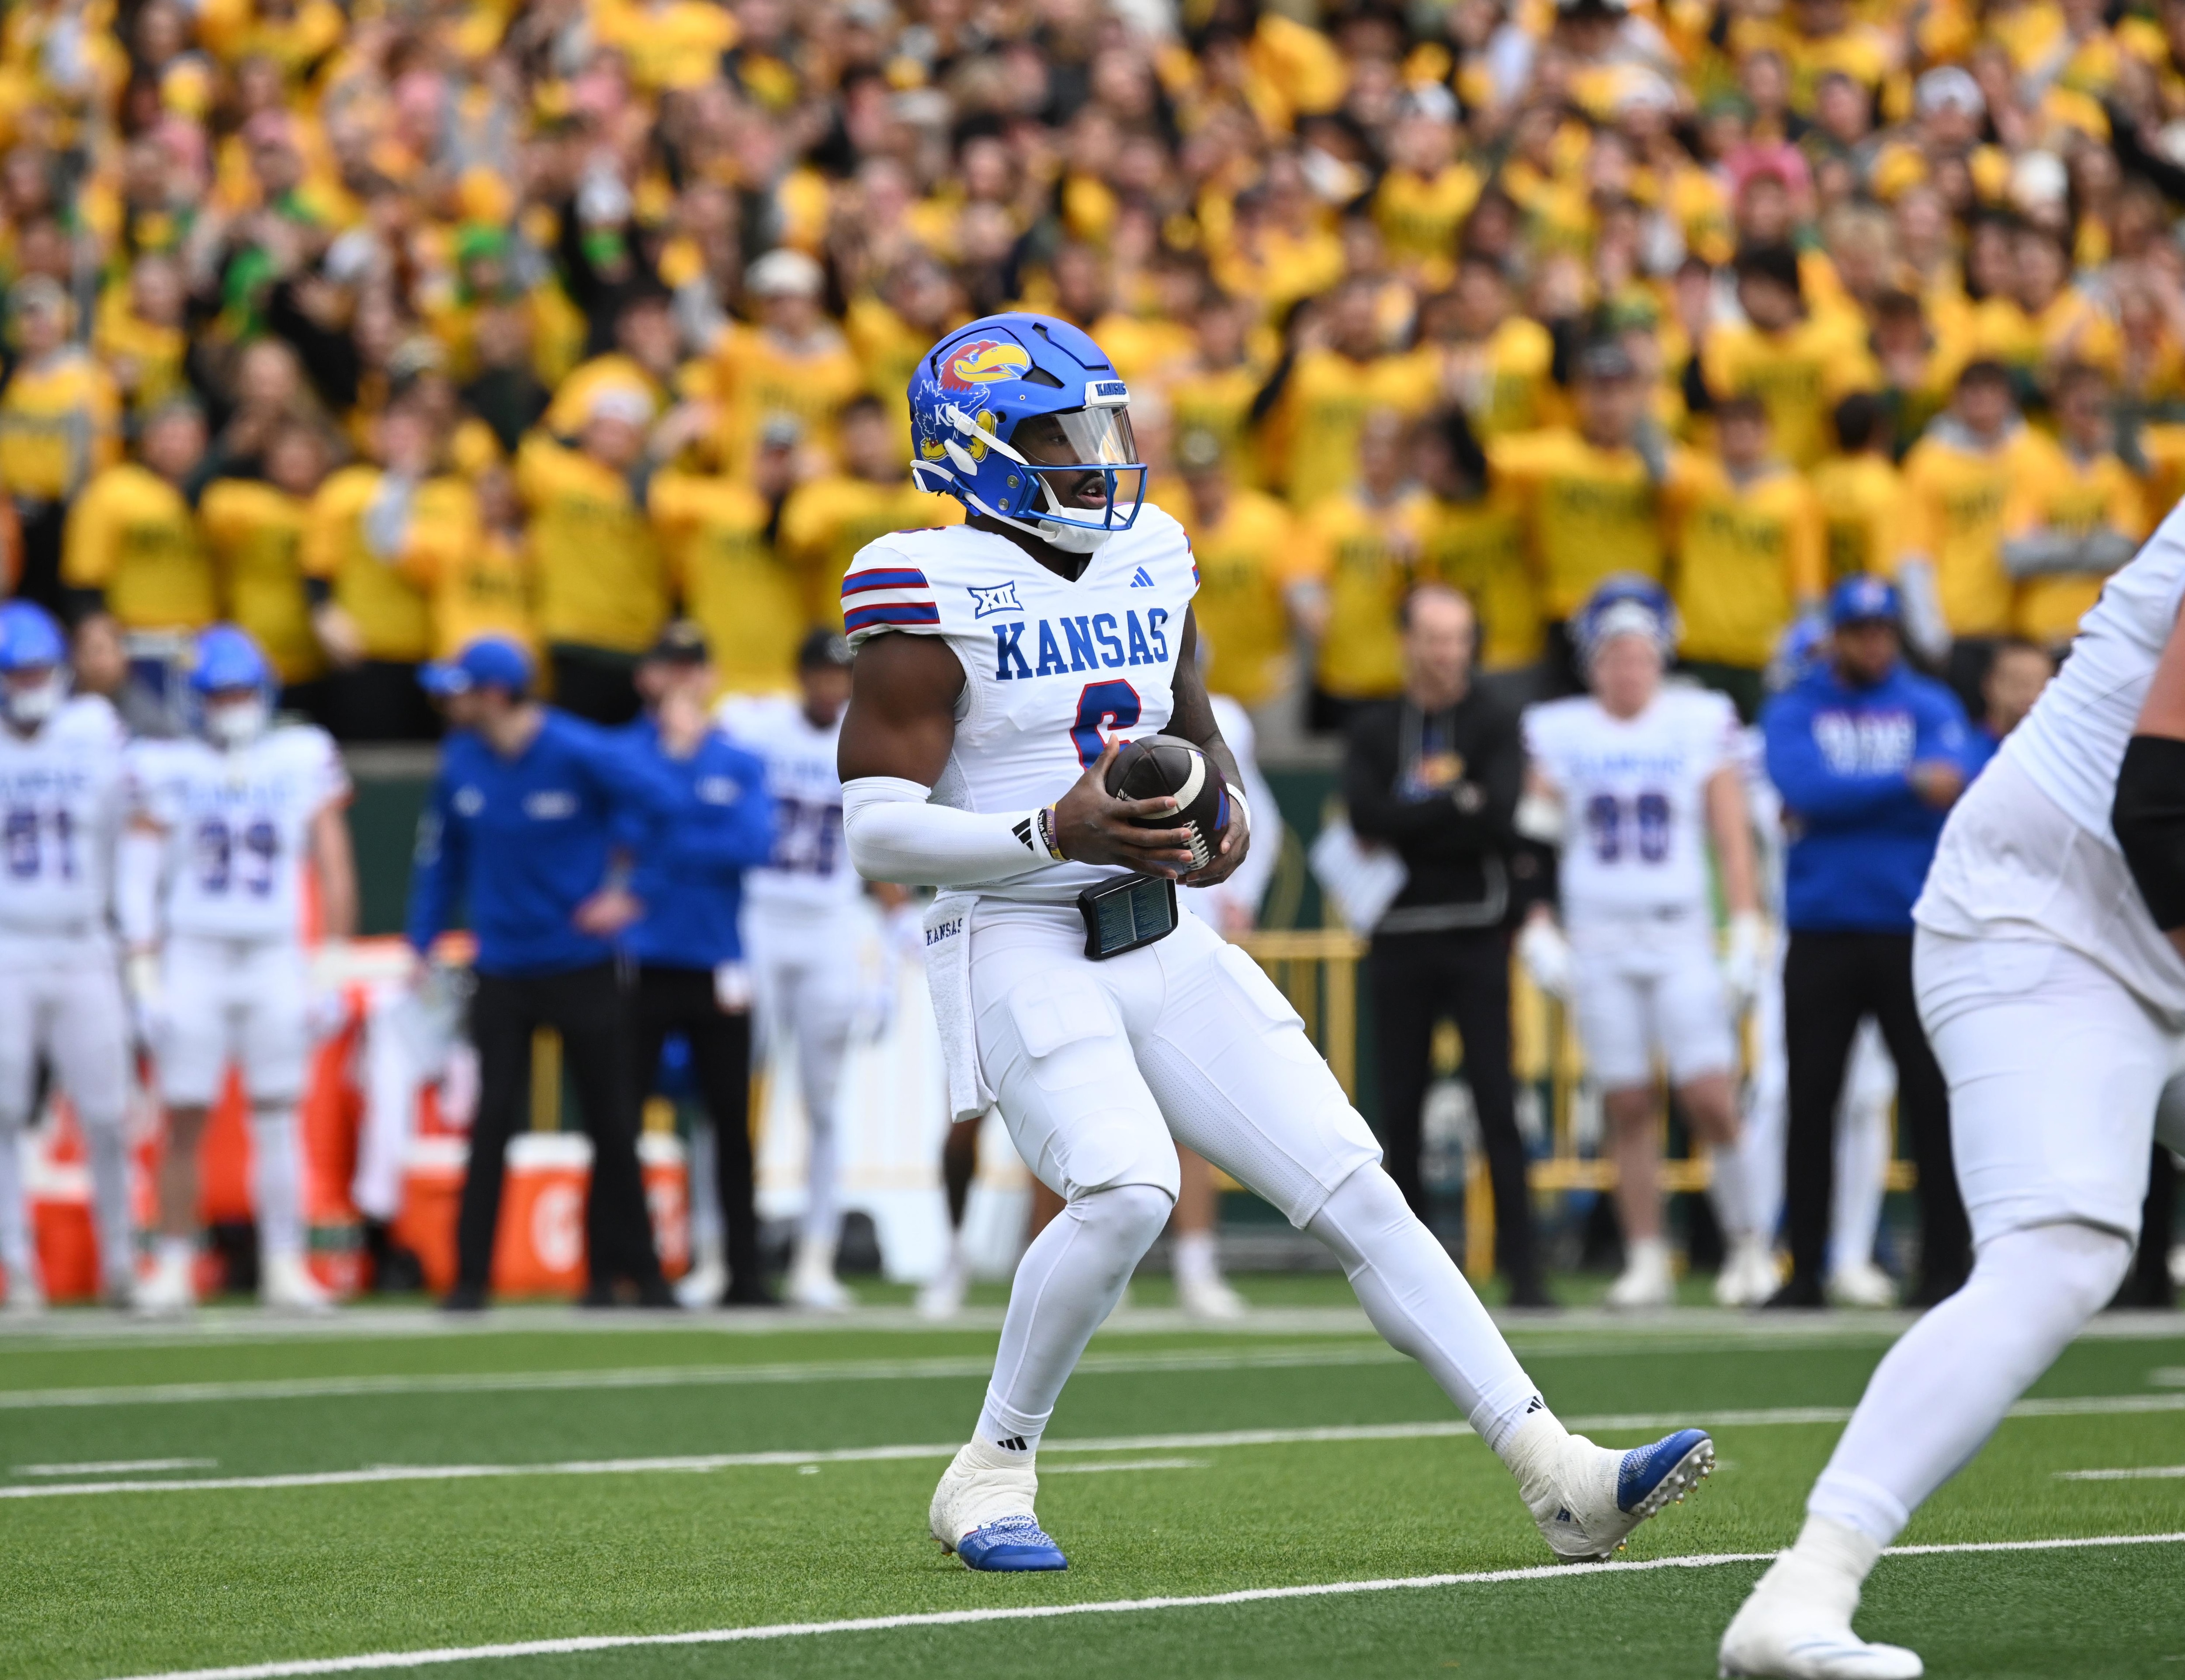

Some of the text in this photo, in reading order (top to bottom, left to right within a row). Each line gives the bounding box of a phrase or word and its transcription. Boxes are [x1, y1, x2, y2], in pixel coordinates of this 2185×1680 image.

[1095, 382, 1127, 396] KANSAS
[992, 608, 1169, 680] KANSAS
[926, 918, 962, 946] KANSAS
